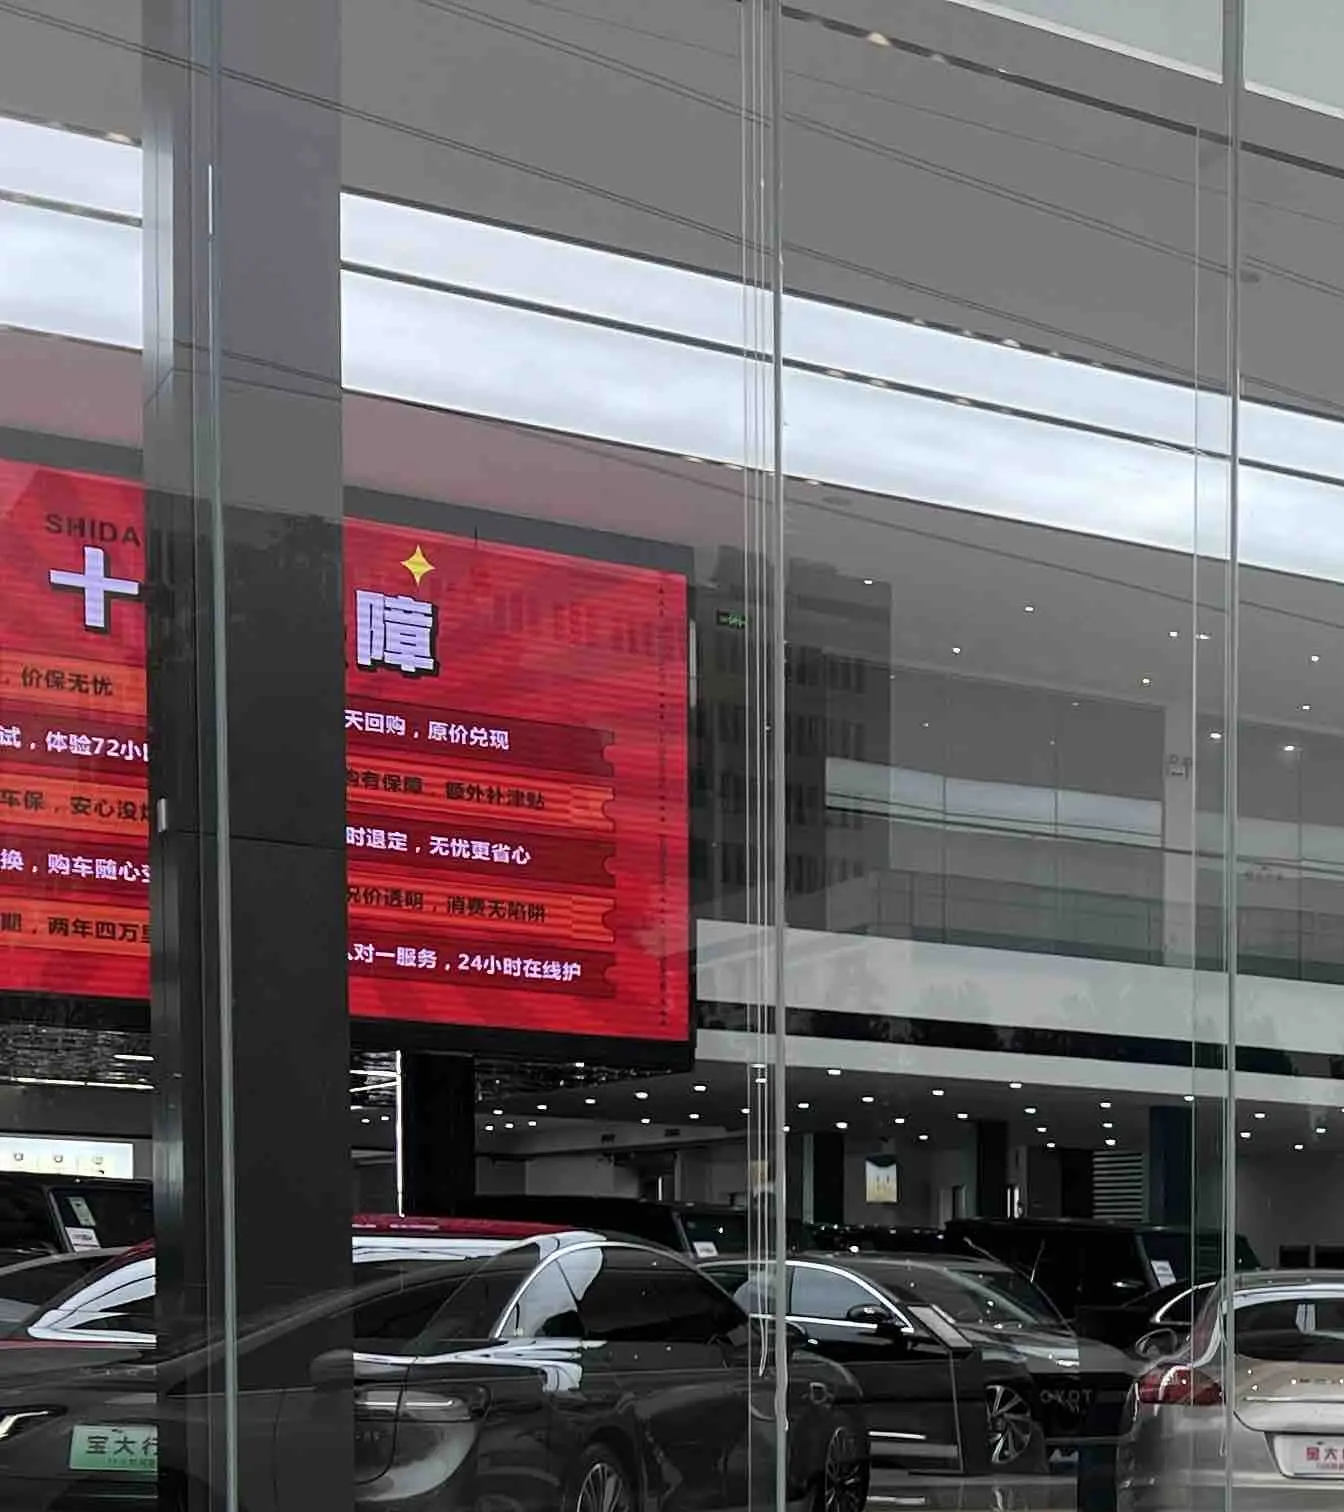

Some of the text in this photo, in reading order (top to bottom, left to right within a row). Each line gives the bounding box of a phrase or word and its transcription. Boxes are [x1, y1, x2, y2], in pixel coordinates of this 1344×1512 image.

[355, 588, 437, 676] 障
[0, 725, 150, 763] 试，体验72小
[345, 943, 583, 983] 对一服务，24小时在线护
